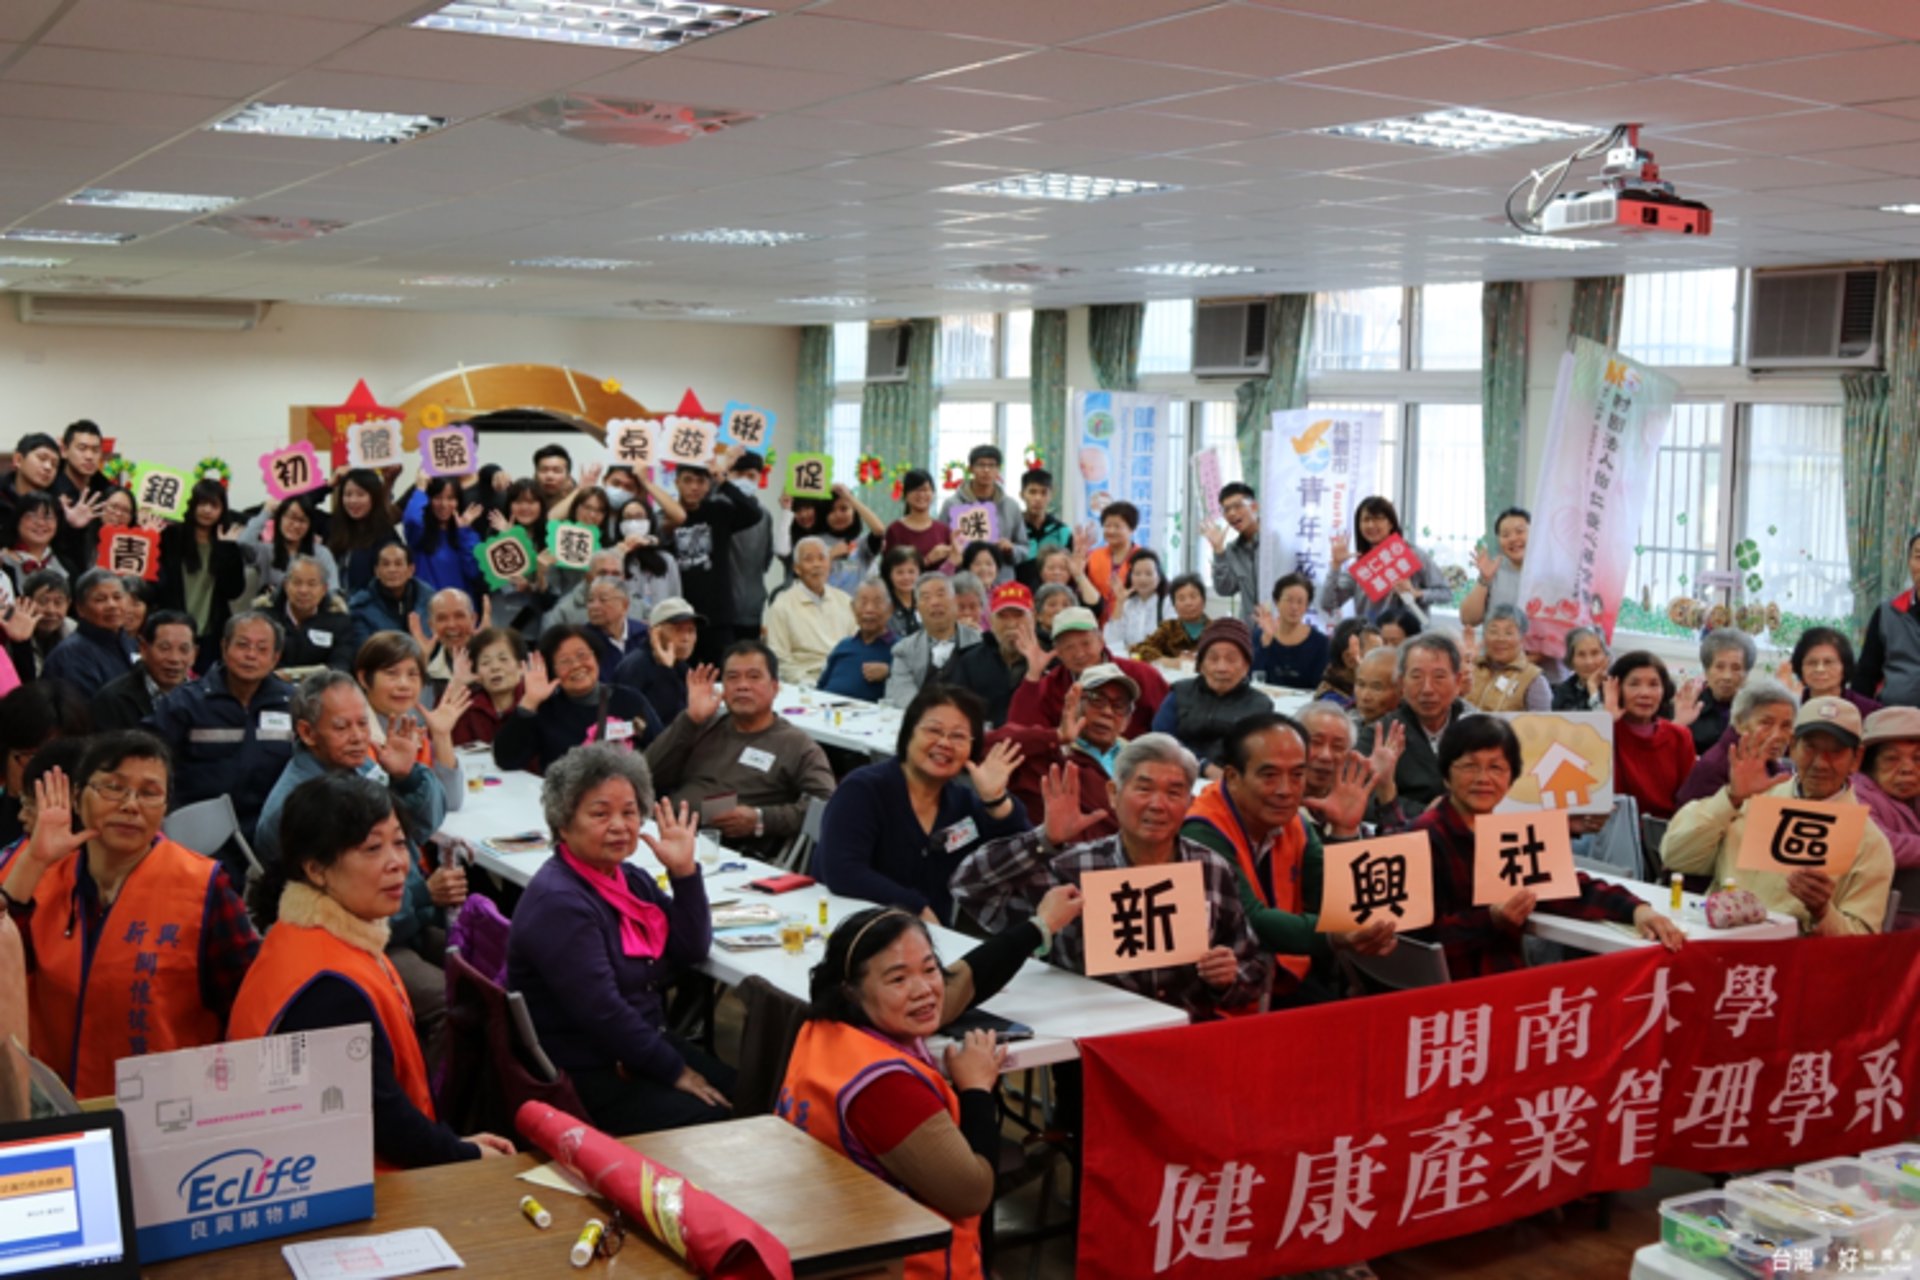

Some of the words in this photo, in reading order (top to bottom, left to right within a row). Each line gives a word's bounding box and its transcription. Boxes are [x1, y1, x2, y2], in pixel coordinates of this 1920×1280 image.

[432, 435, 467, 469] 驗
[619, 428, 649, 460] 桌
[672, 428, 704, 457] 遊
[274, 454, 308, 488] 初
[794, 460, 824, 490] 促
[143, 474, 180, 510] 銀
[960, 511, 988, 538] 咪
[113, 536, 147, 575] 青
[490, 540, 526, 576] 園
[559, 527, 592, 563] 藝
[1499, 823, 1552, 886] 社
[1770, 808, 1837, 866] 區
[1349, 851, 1409, 924] 興
[1110, 878, 1178, 958] 新
[1405, 962, 1780, 1098] 開南大學
[1149, 1039, 1905, 1275] 健康產業管理學系
[190, 1200, 309, 1241] 良興購物網
